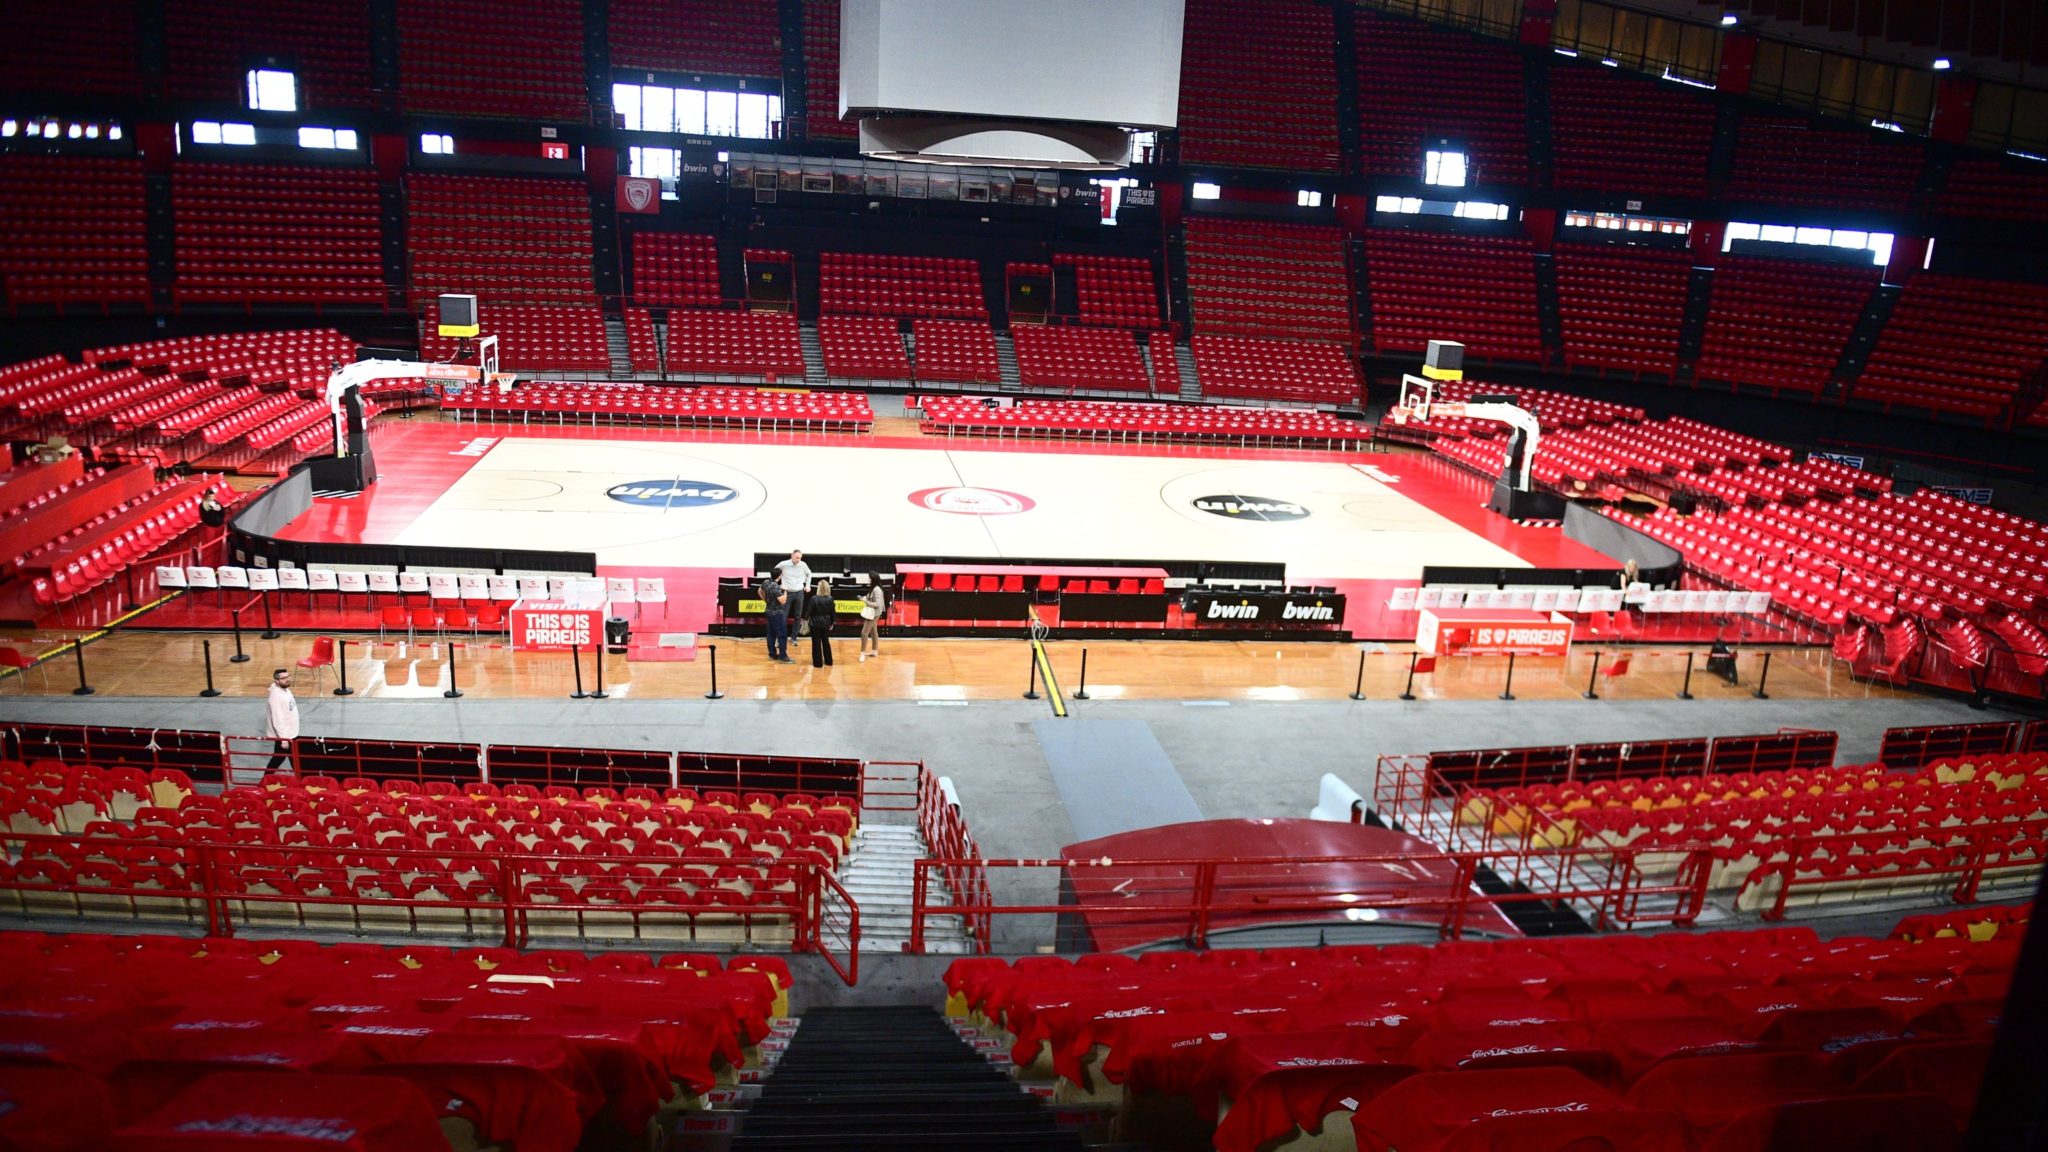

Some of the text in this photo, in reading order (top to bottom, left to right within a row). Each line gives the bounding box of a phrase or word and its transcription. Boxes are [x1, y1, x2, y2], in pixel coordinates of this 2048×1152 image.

[684, 163, 708, 173] bwin
[1075, 188, 1098, 197] bwin
[1127, 188, 1155, 198] THIS IS
[610, 486, 734, 500] bwin
[1196, 500, 1305, 515] bwin
[1207, 599, 1260, 619] bwin
[1282, 600, 1334, 620] bwin
[525, 613, 590, 629] THIS IS
[1477, 629, 1492, 645] IS
[727, 1091, 736, 1102] 7
[684, 1118, 716, 1131] Row
